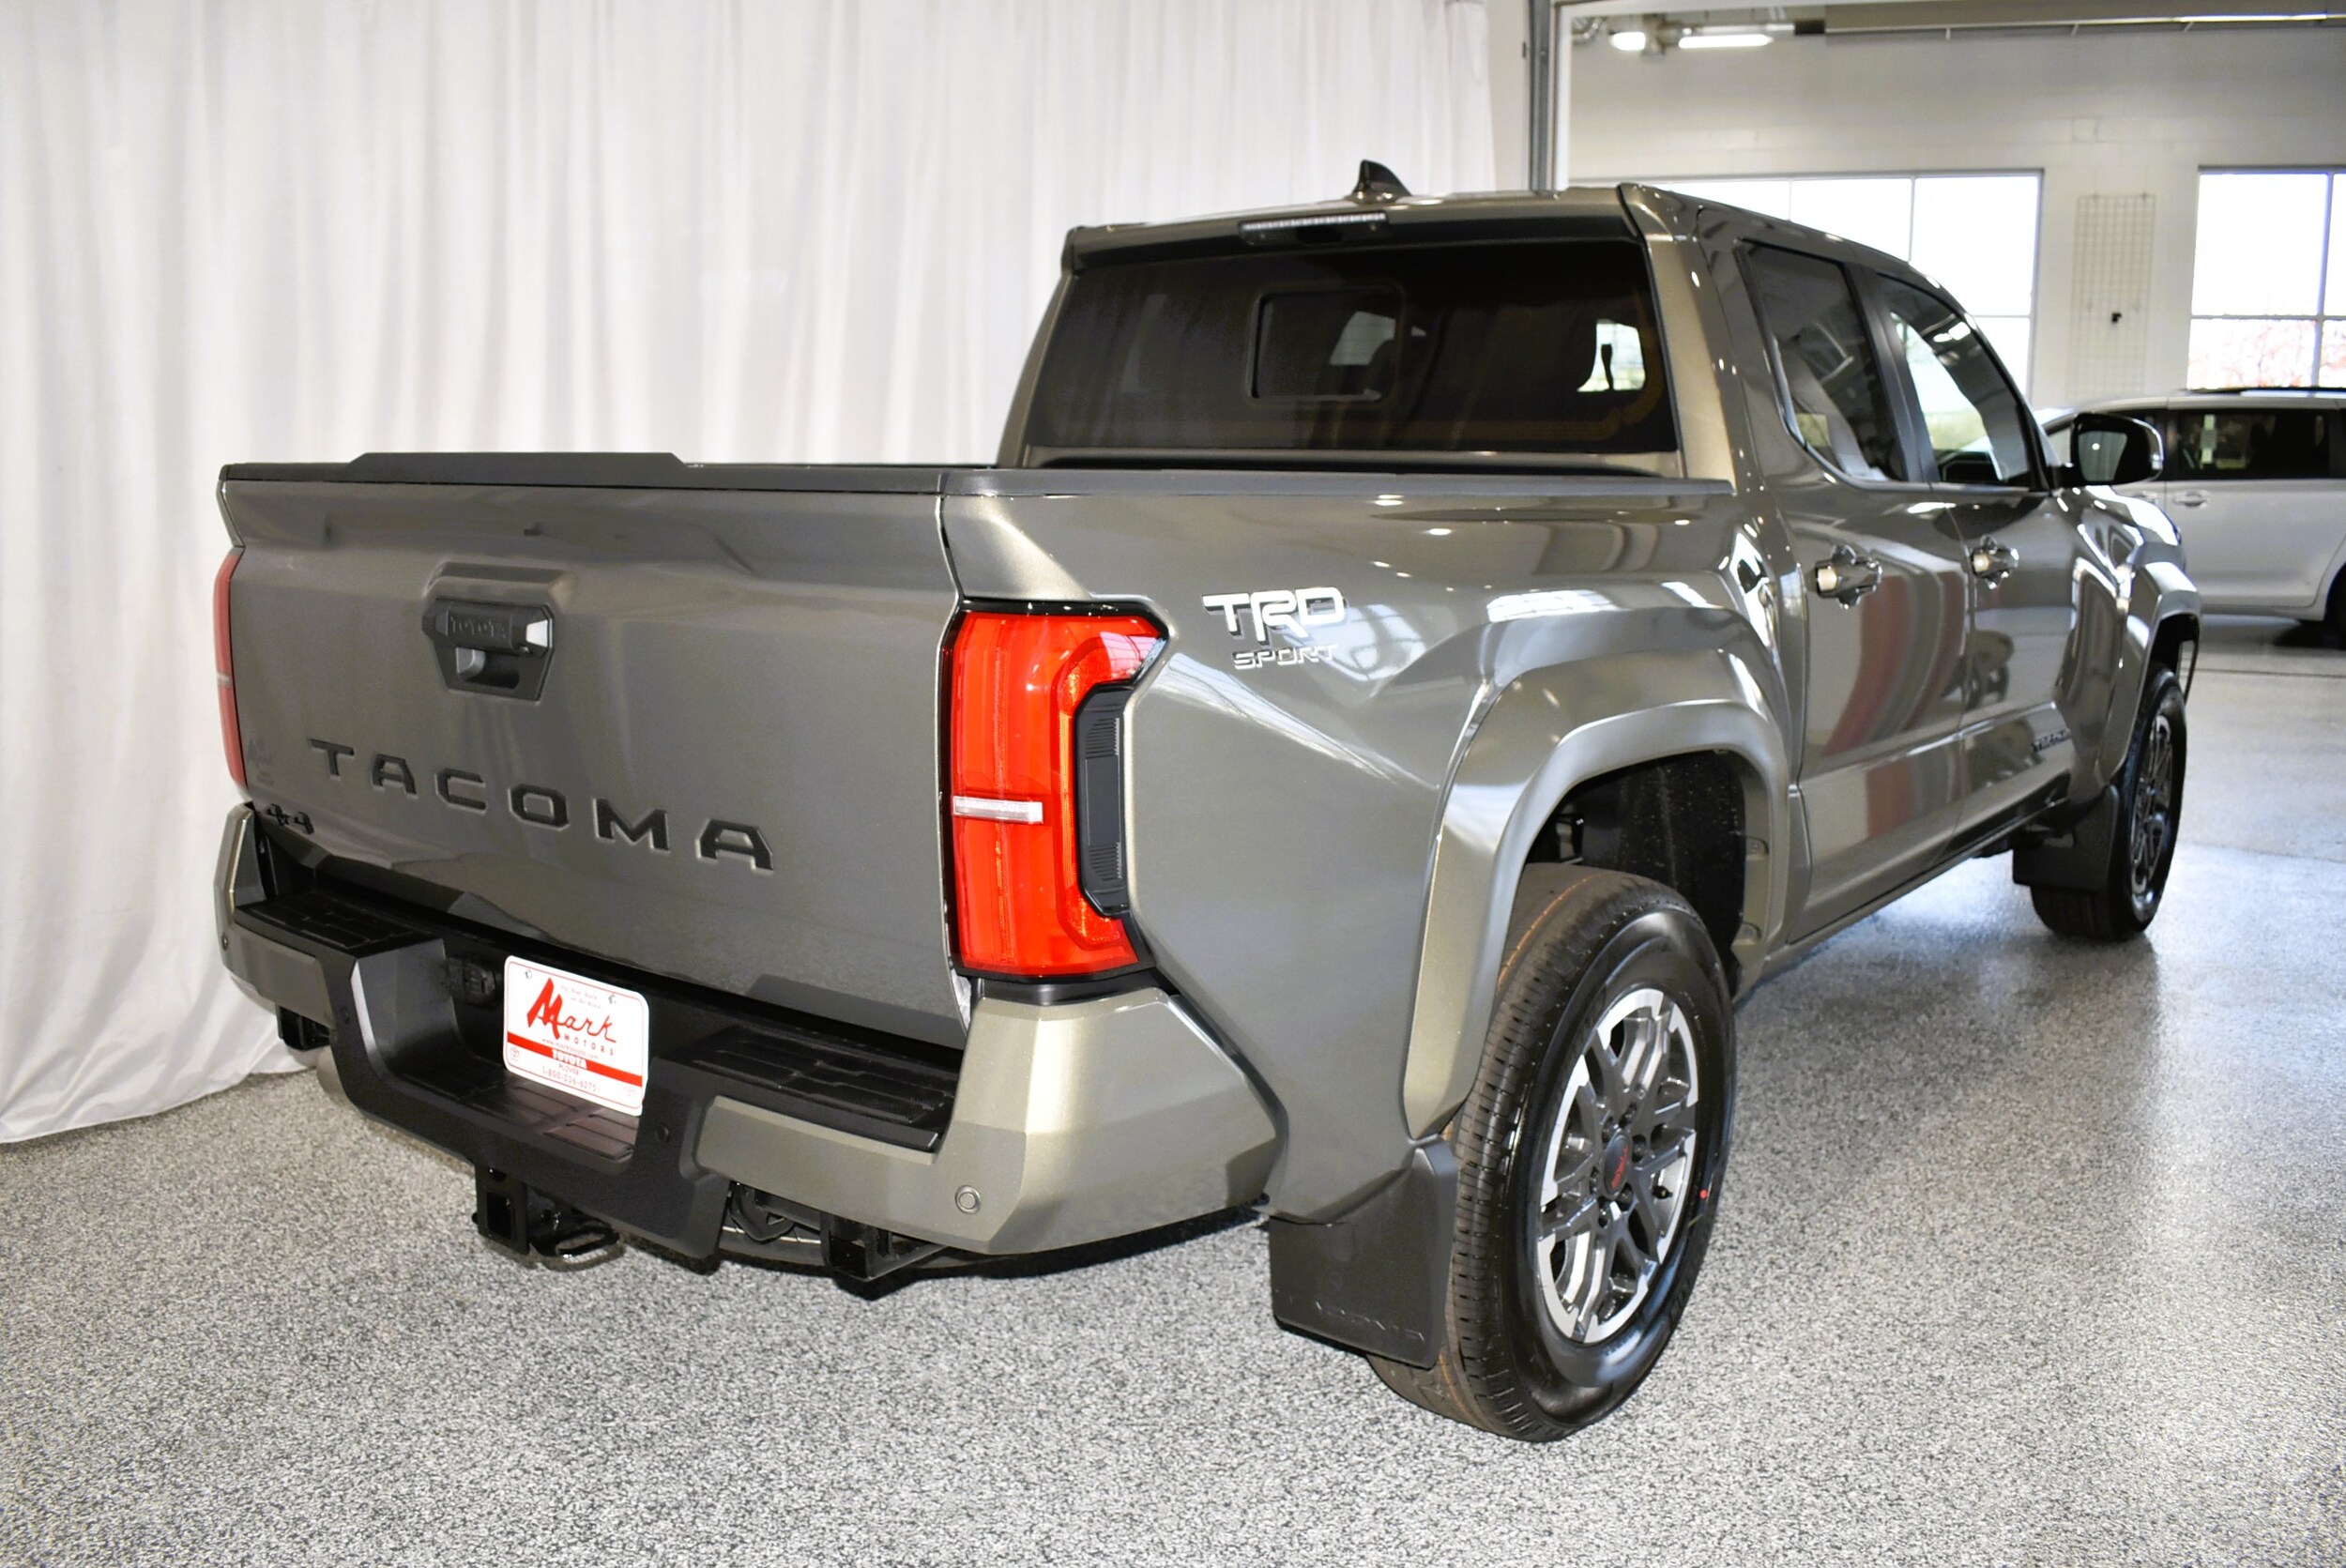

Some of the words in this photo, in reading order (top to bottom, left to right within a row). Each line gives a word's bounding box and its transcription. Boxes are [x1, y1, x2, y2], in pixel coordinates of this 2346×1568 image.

[1202, 586, 1346, 643] TRD
[1233, 644, 1339, 670] SPORT
[308, 738, 773, 872] TACOMA
[526, 977, 617, 1043] Mark
[552, 1049, 587, 1070] TOYOTA
[564, 1033, 615, 1056] MOTORS
